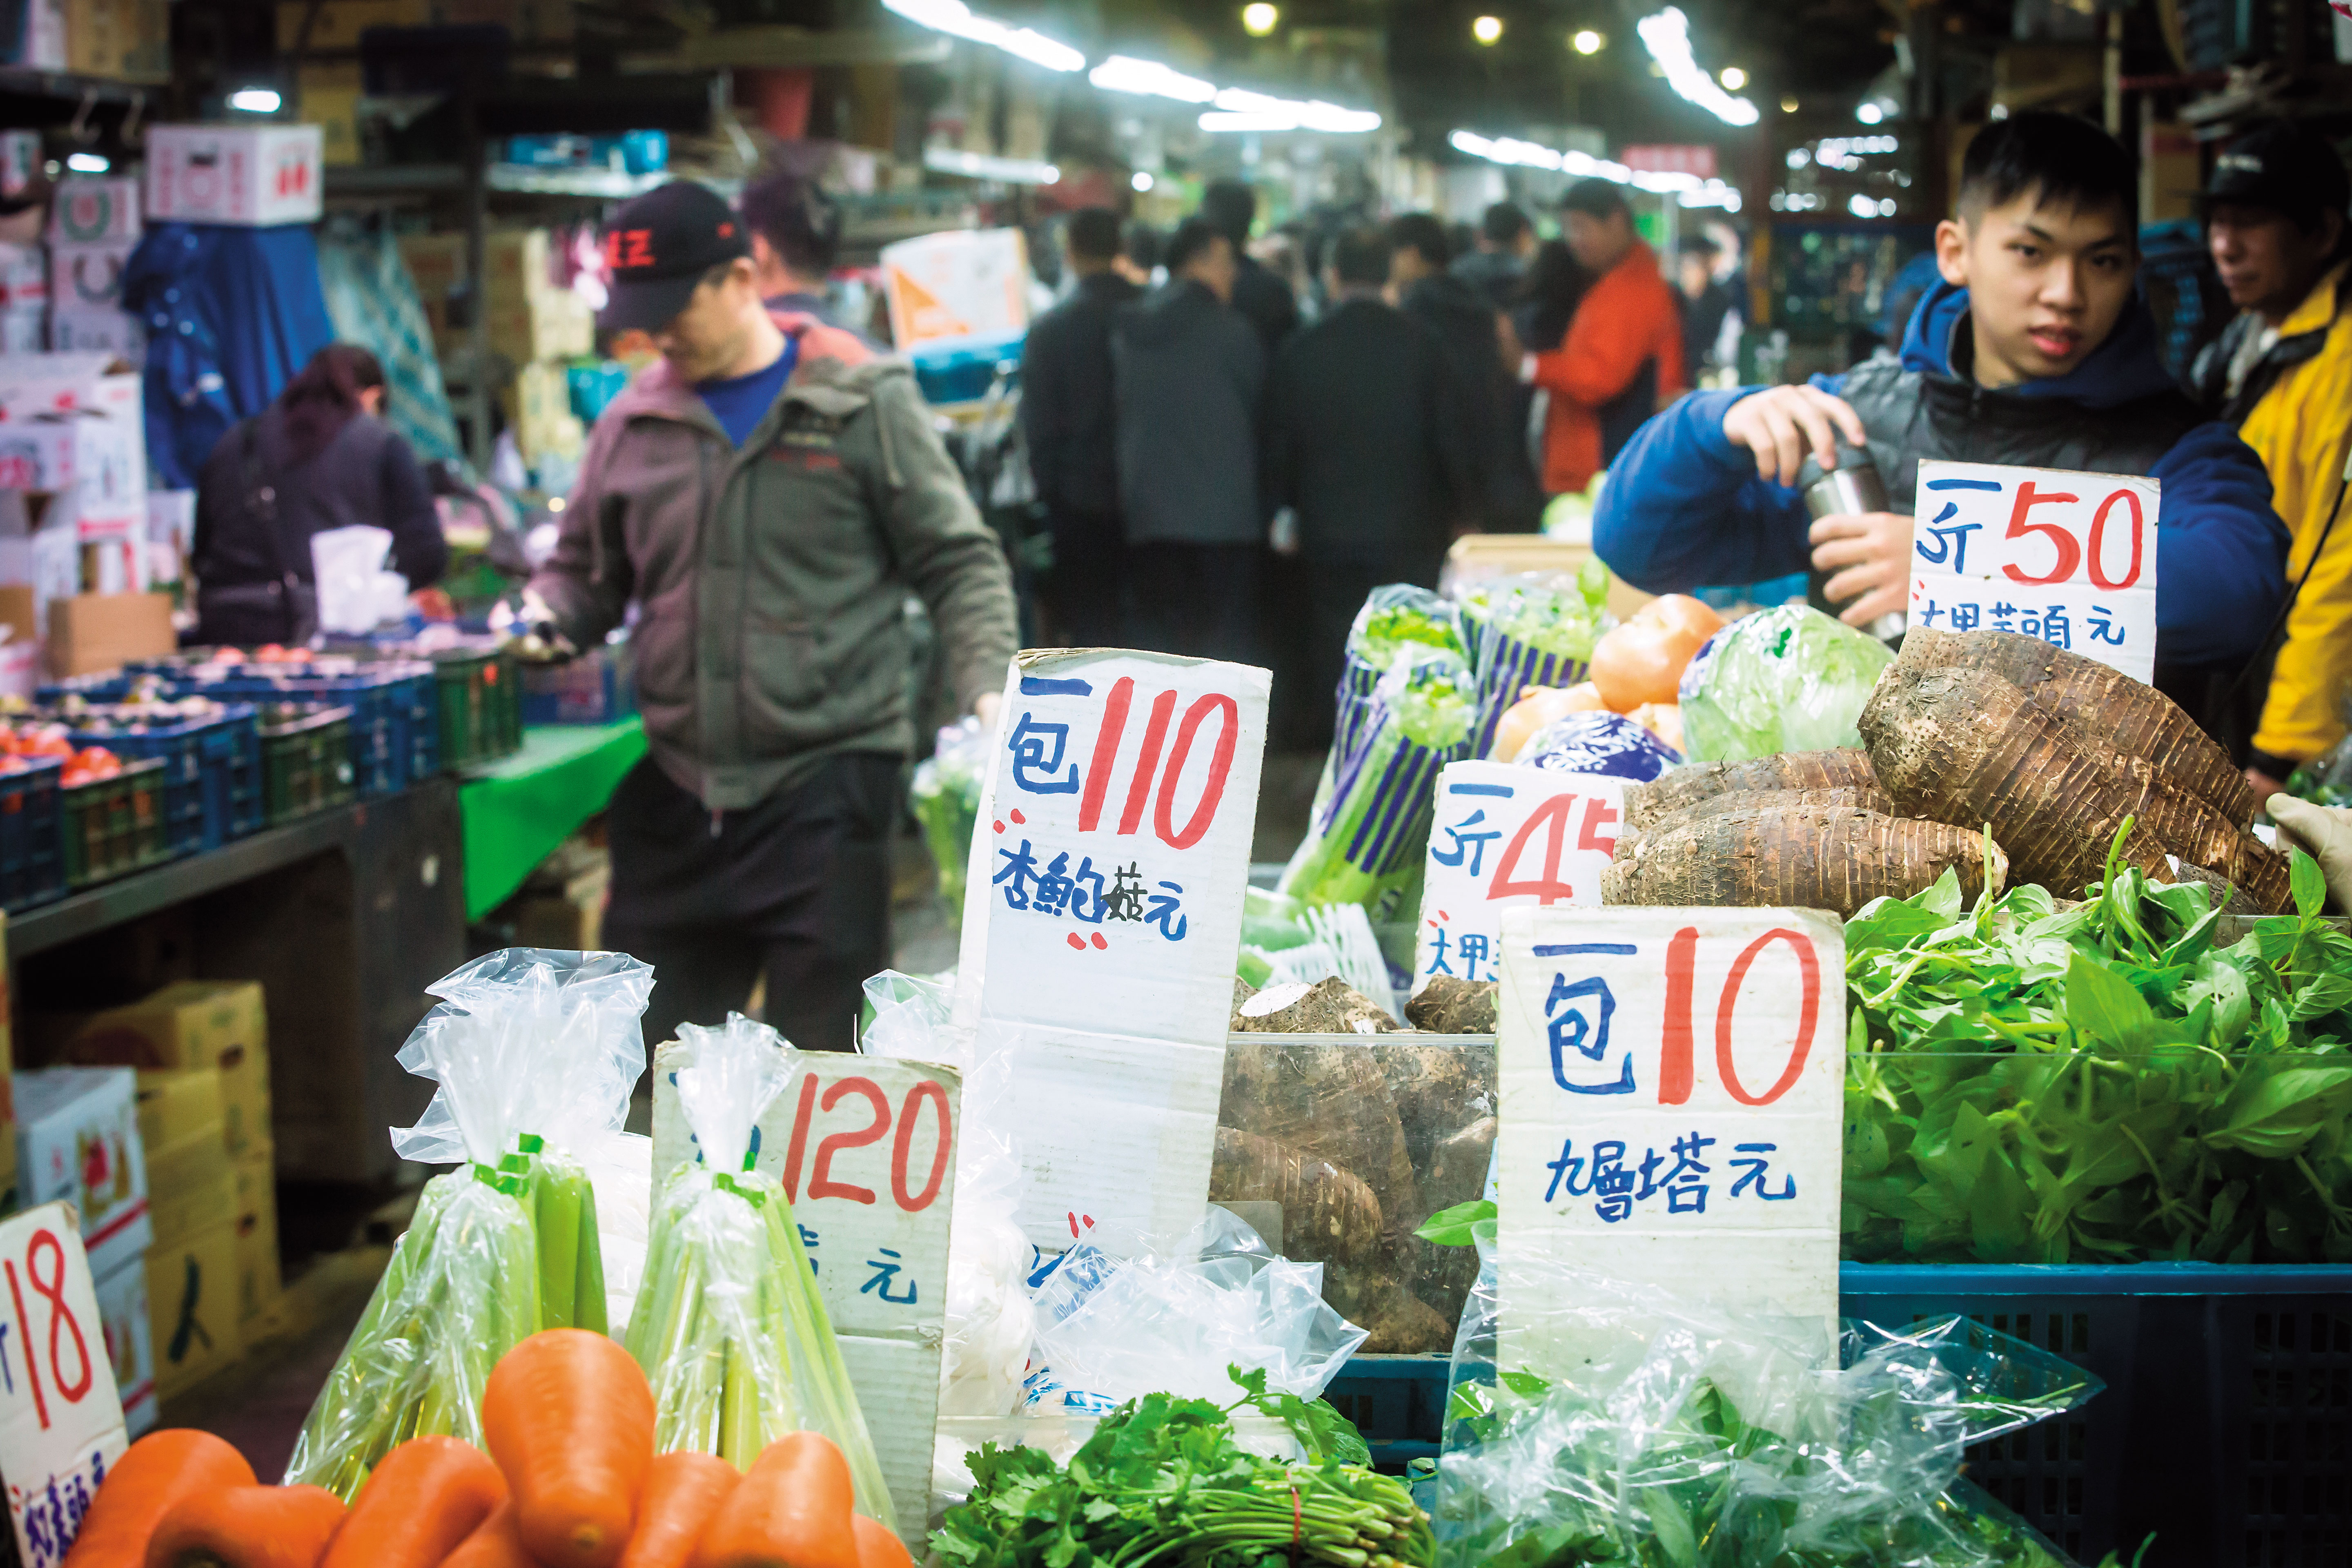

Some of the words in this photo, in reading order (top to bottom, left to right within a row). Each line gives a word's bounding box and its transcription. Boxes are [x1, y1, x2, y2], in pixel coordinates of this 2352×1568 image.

[2002, 481, 2143, 591] 50
[1079, 676, 1238, 850] 110
[1658, 926, 1820, 1106] 10
[782, 1072, 952, 1212] 120
[3, 1229, 93, 1430] 18
[860, 1248, 917, 1304] 元
